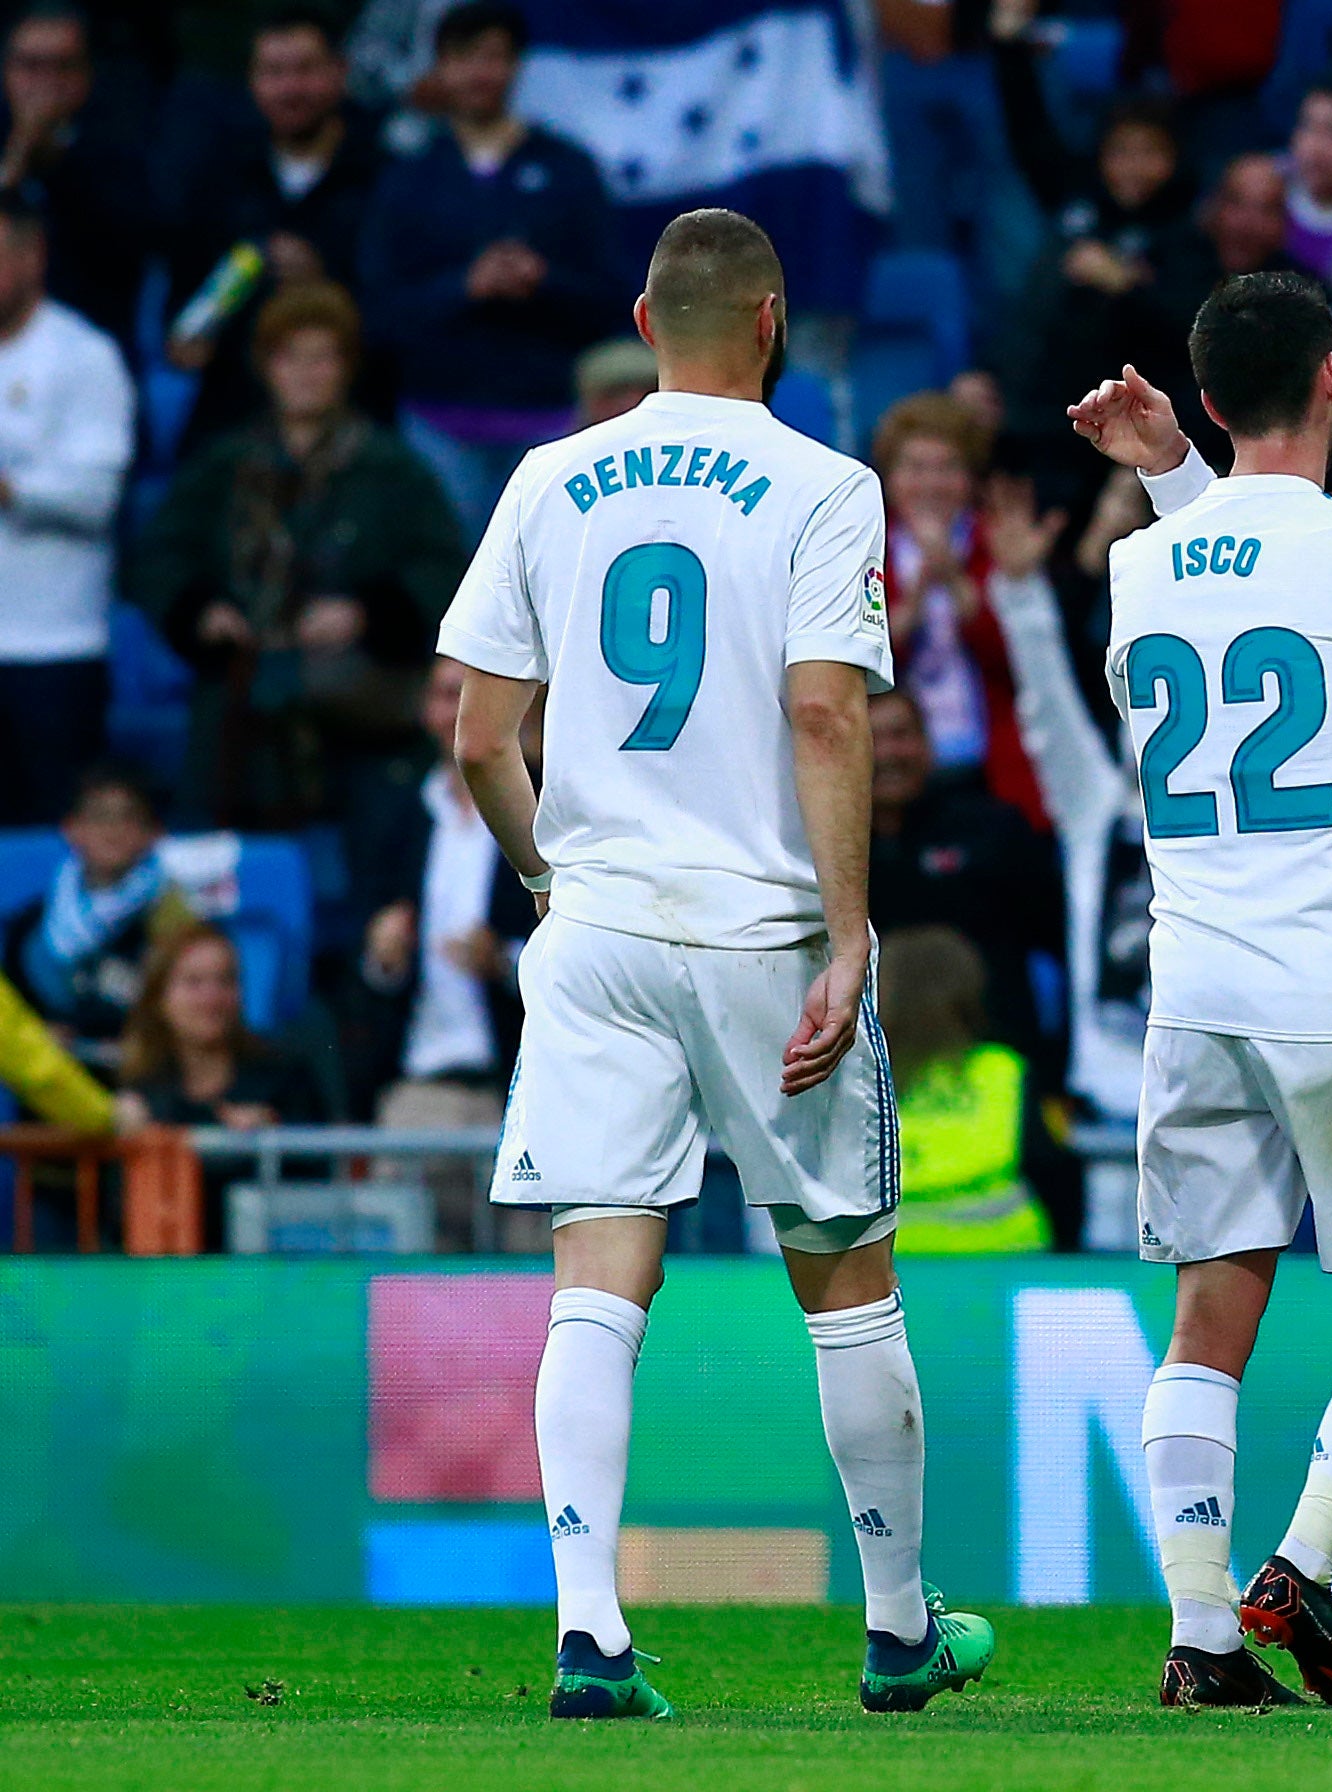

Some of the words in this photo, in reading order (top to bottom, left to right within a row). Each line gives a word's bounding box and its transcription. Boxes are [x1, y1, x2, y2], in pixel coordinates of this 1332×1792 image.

[564, 445, 772, 516] BENZEMA
[1172, 535, 1261, 581] ISCO
[600, 541, 708, 751] 9
[511, 1168, 542, 1181] adidas
[1175, 1511, 1227, 1528] adidas
